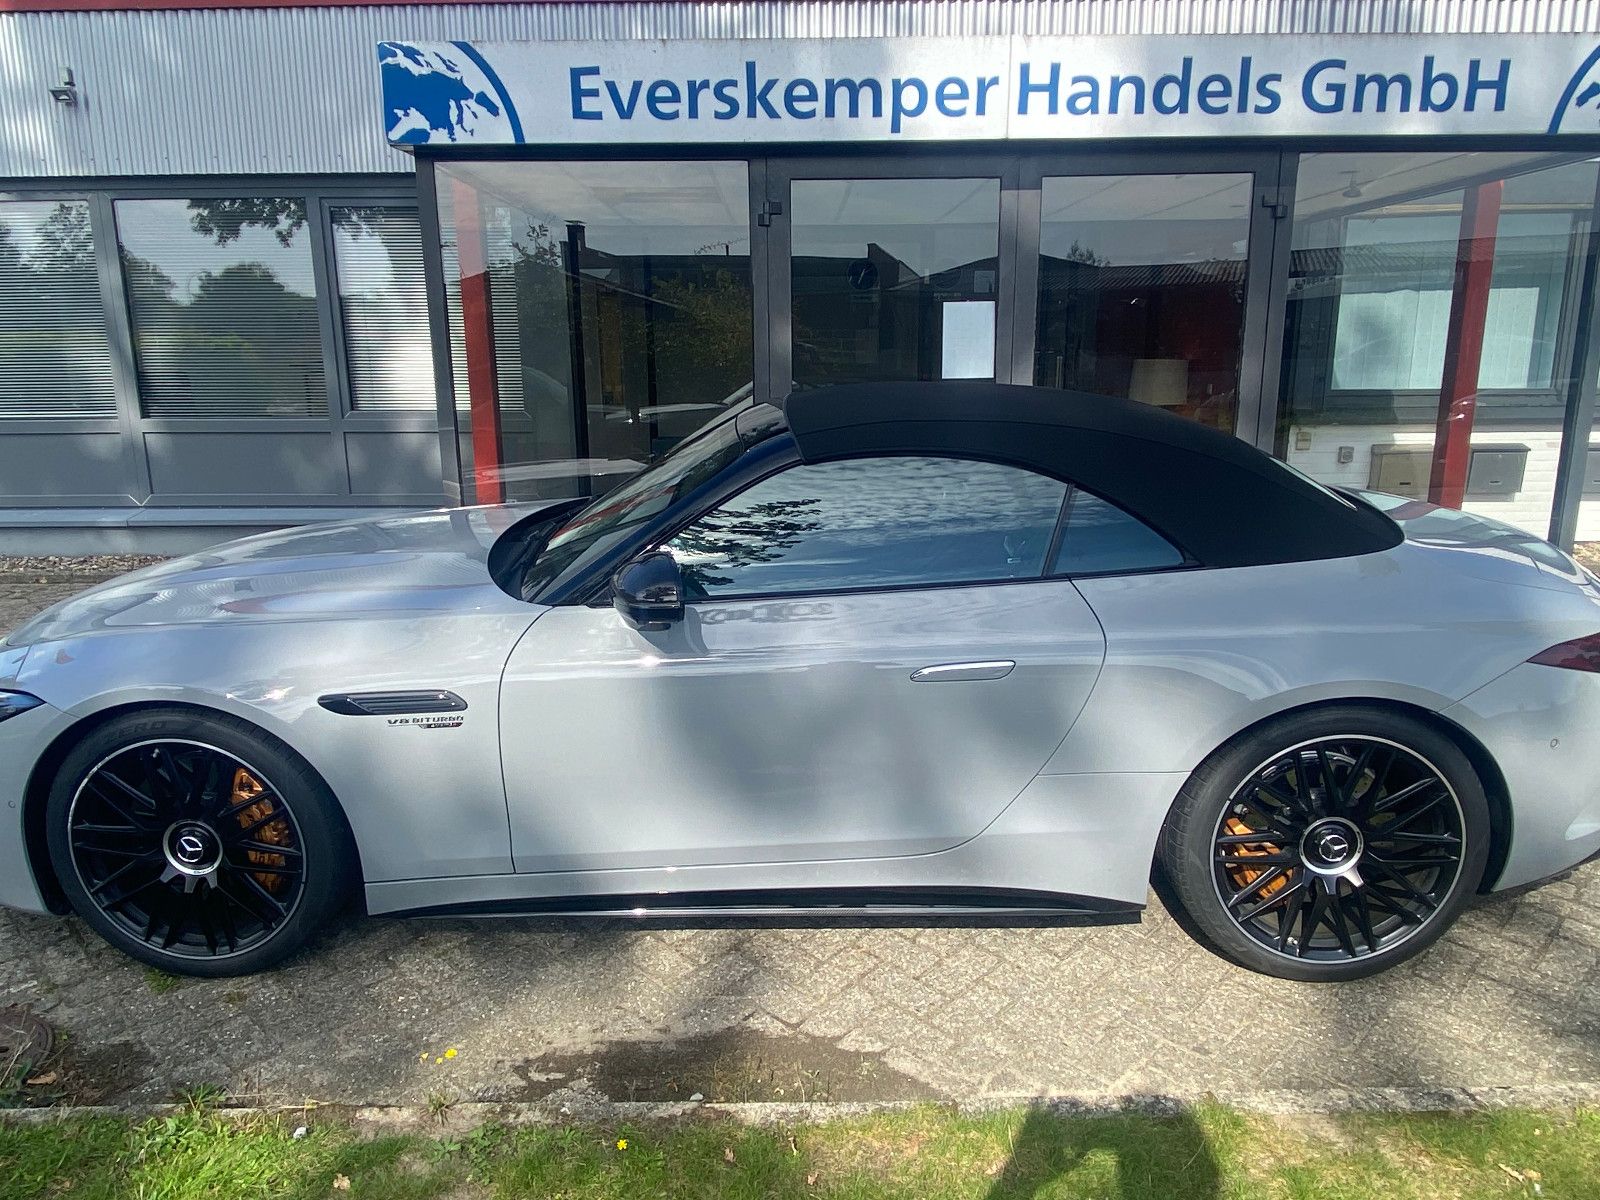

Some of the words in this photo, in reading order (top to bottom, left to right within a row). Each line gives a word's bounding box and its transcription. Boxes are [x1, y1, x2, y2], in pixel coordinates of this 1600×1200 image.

[569, 60, 999, 134] Everskemper
[1017, 56, 1283, 116] Handels
[1301, 55, 1512, 114] GmbH
[412, 715, 464, 724] BITURBO
